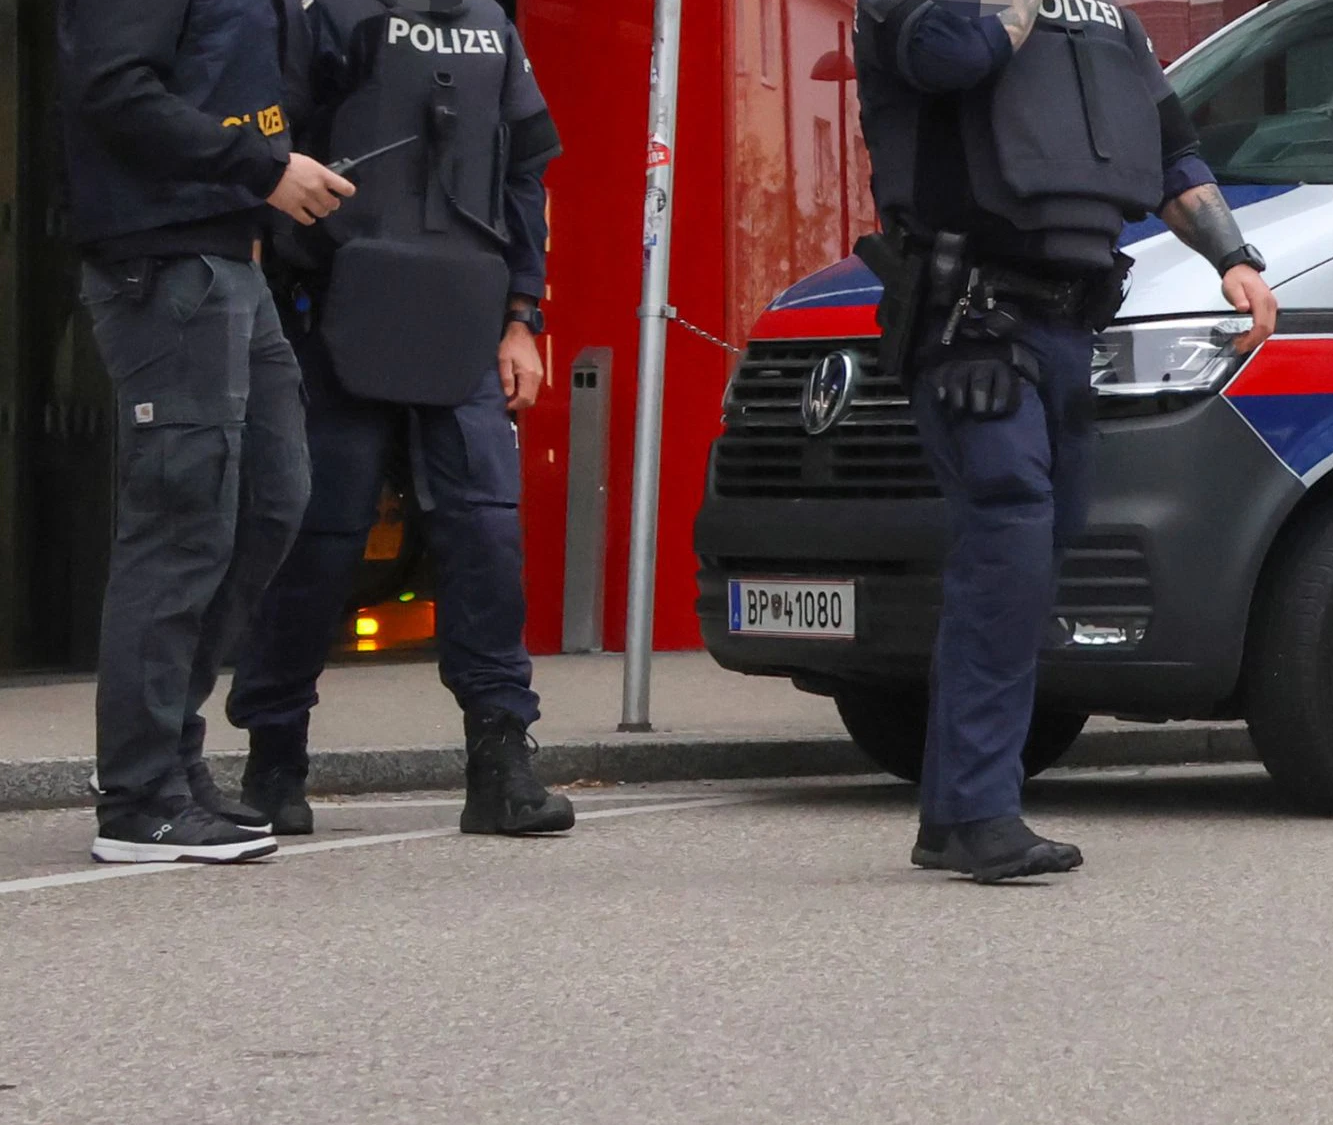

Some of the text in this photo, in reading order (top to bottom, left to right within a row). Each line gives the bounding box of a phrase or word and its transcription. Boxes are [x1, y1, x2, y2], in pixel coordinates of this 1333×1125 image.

[388, 17, 504, 54] POLIZEI
[747, 589, 769, 626] BP
[784, 590, 842, 629] 41080
